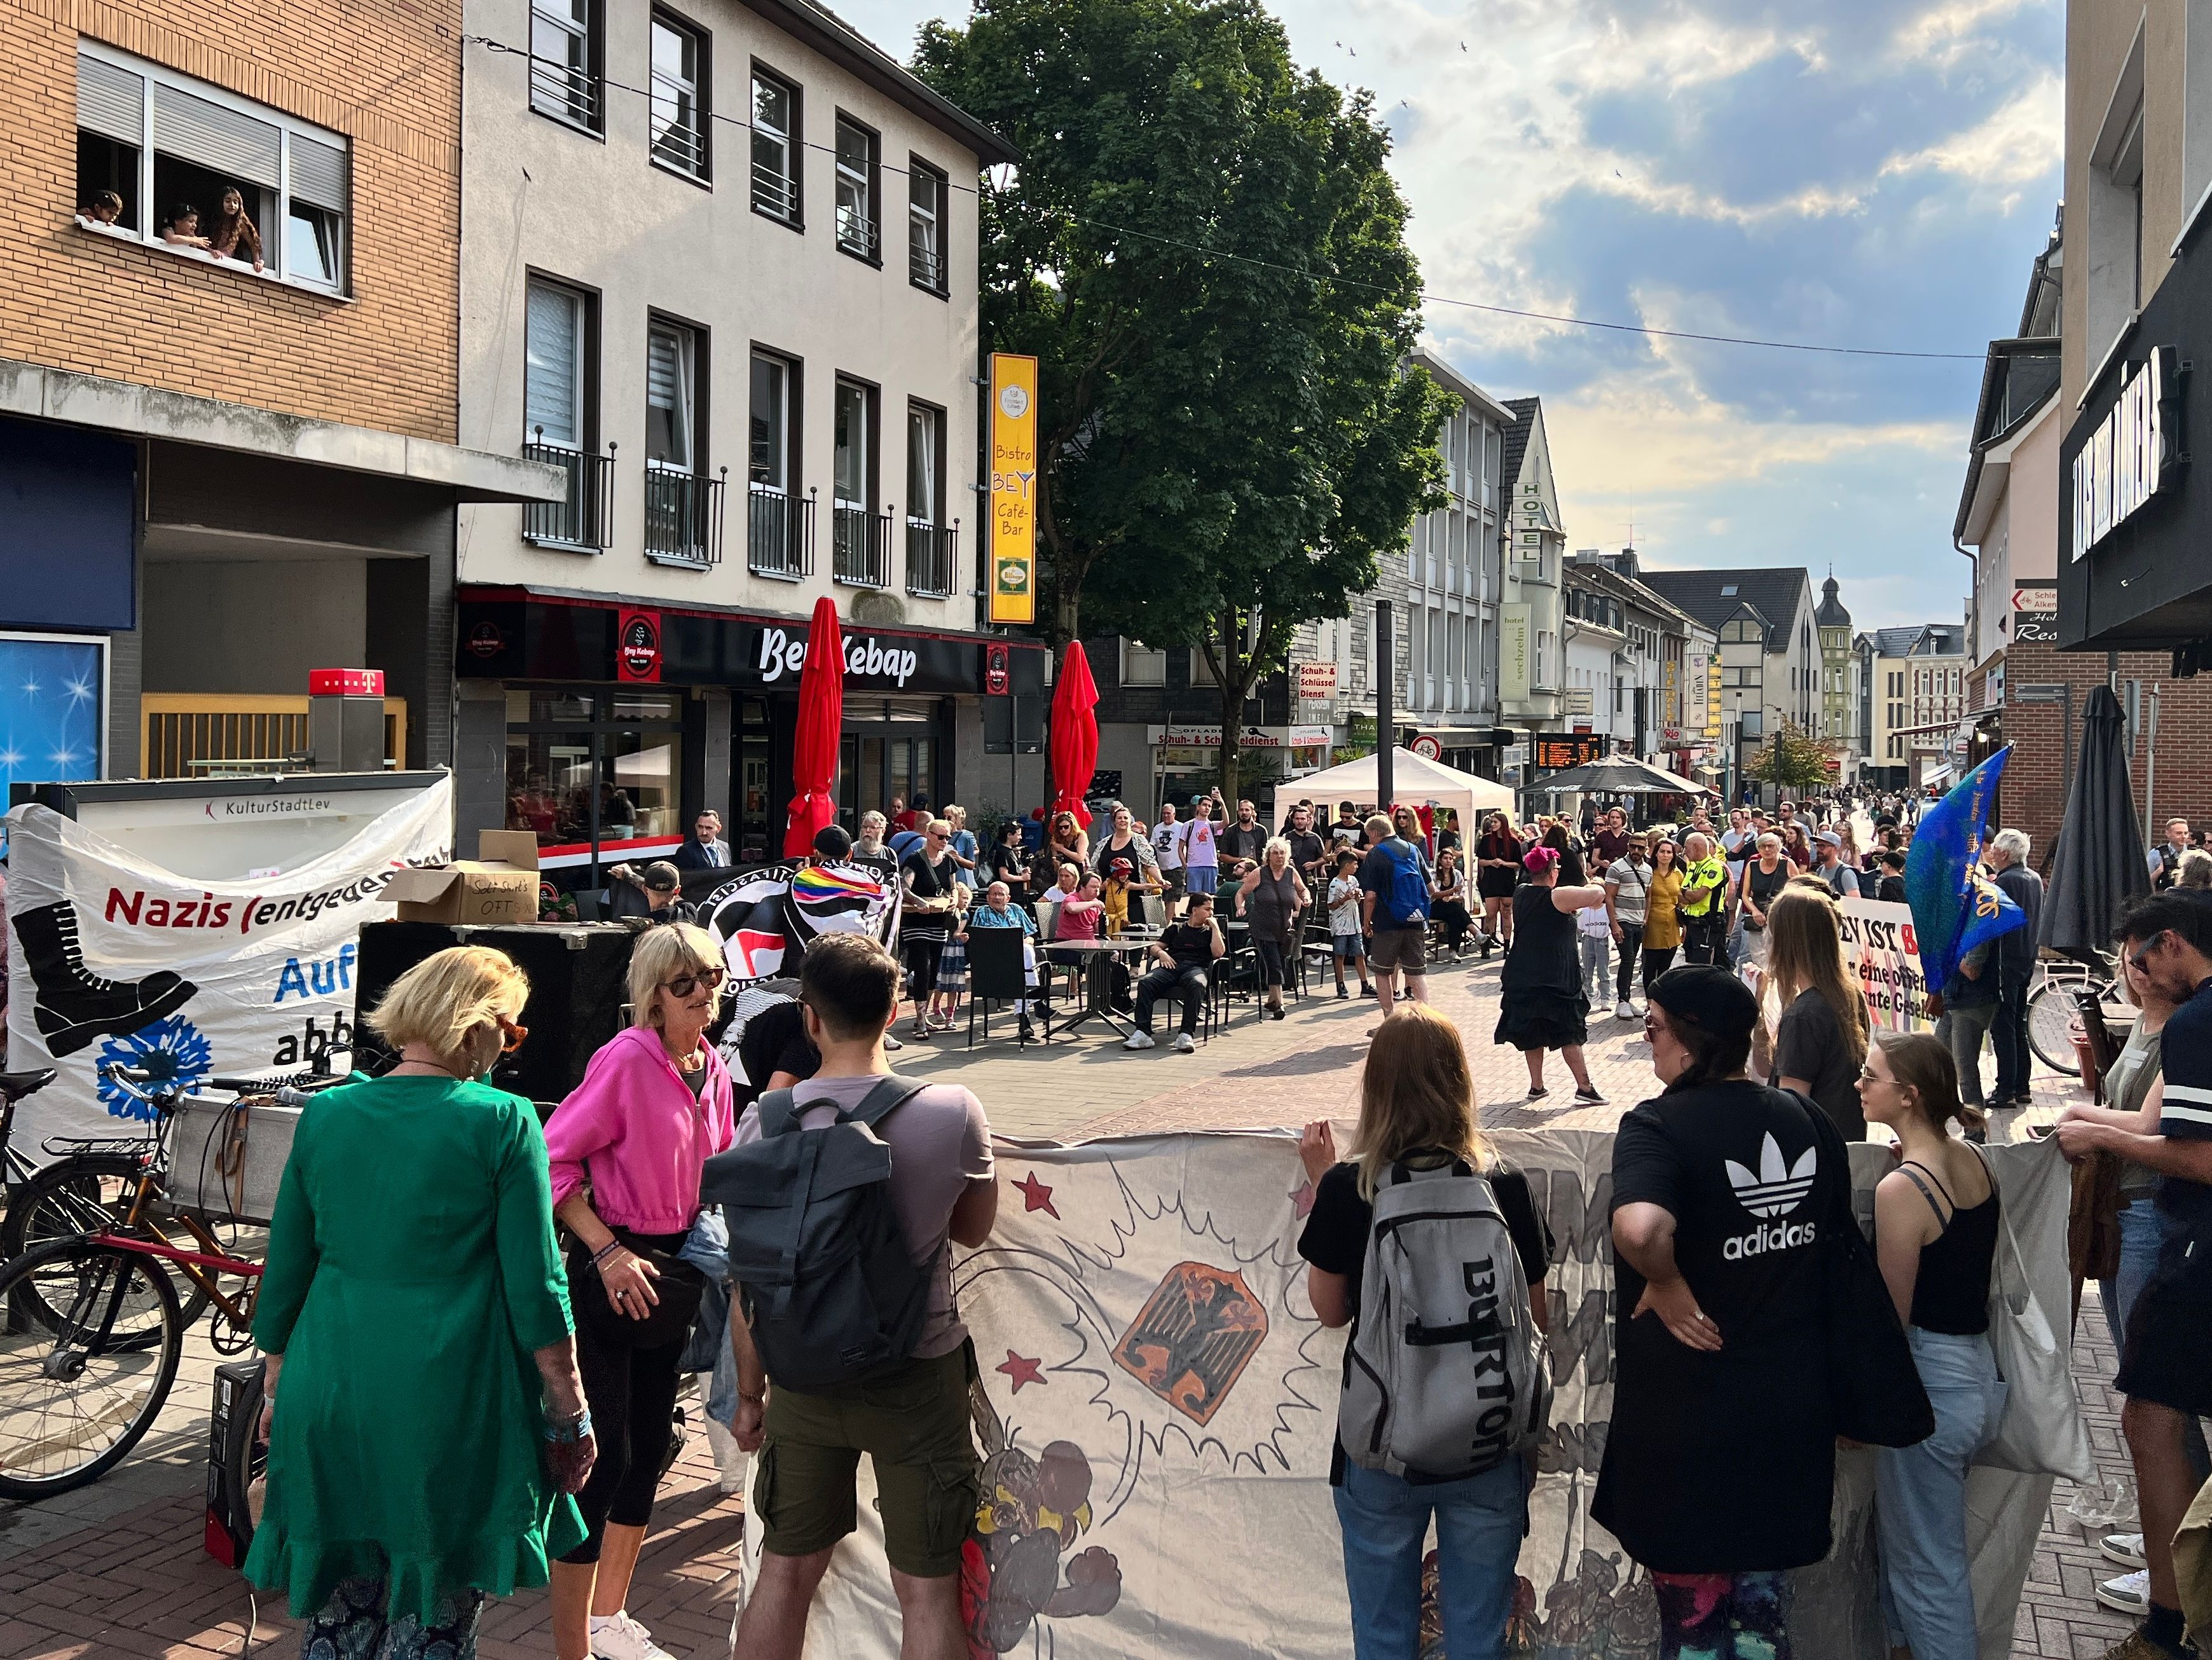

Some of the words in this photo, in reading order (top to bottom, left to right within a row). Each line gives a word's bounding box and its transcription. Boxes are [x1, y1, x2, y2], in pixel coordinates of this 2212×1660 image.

[996, 445, 1031, 460] Bistro
[993, 470, 1034, 498] BEY
[998, 503, 1029, 519] Café-
[1523, 485, 1539, 560] HOTEL
[1003, 521, 1023, 535] Bar
[759, 628, 809, 682] Be
[1515, 628, 1524, 680] sechzehn
[362, 672, 376, 694] T
[1300, 678, 1335, 687] Schlüssel
[1300, 690, 1325, 698] Dienst
[1194, 736, 1201, 744] &
[1205, 736, 1279, 745] Scheldienst
[1663, 729, 1679, 740] Rio
[226, 798, 330, 814] KulturStadtLev
[105, 888, 232, 928] Nazis
[1840, 916, 1860, 945] EV
[1864, 919, 1897, 951] IST
[1901, 924, 1918, 956] B
[273, 942, 360, 1003] Auf
[1859, 959, 1890, 984] eine
[1893, 965, 1927, 992] offen
[1723, 1220, 1815, 1260] adidas
